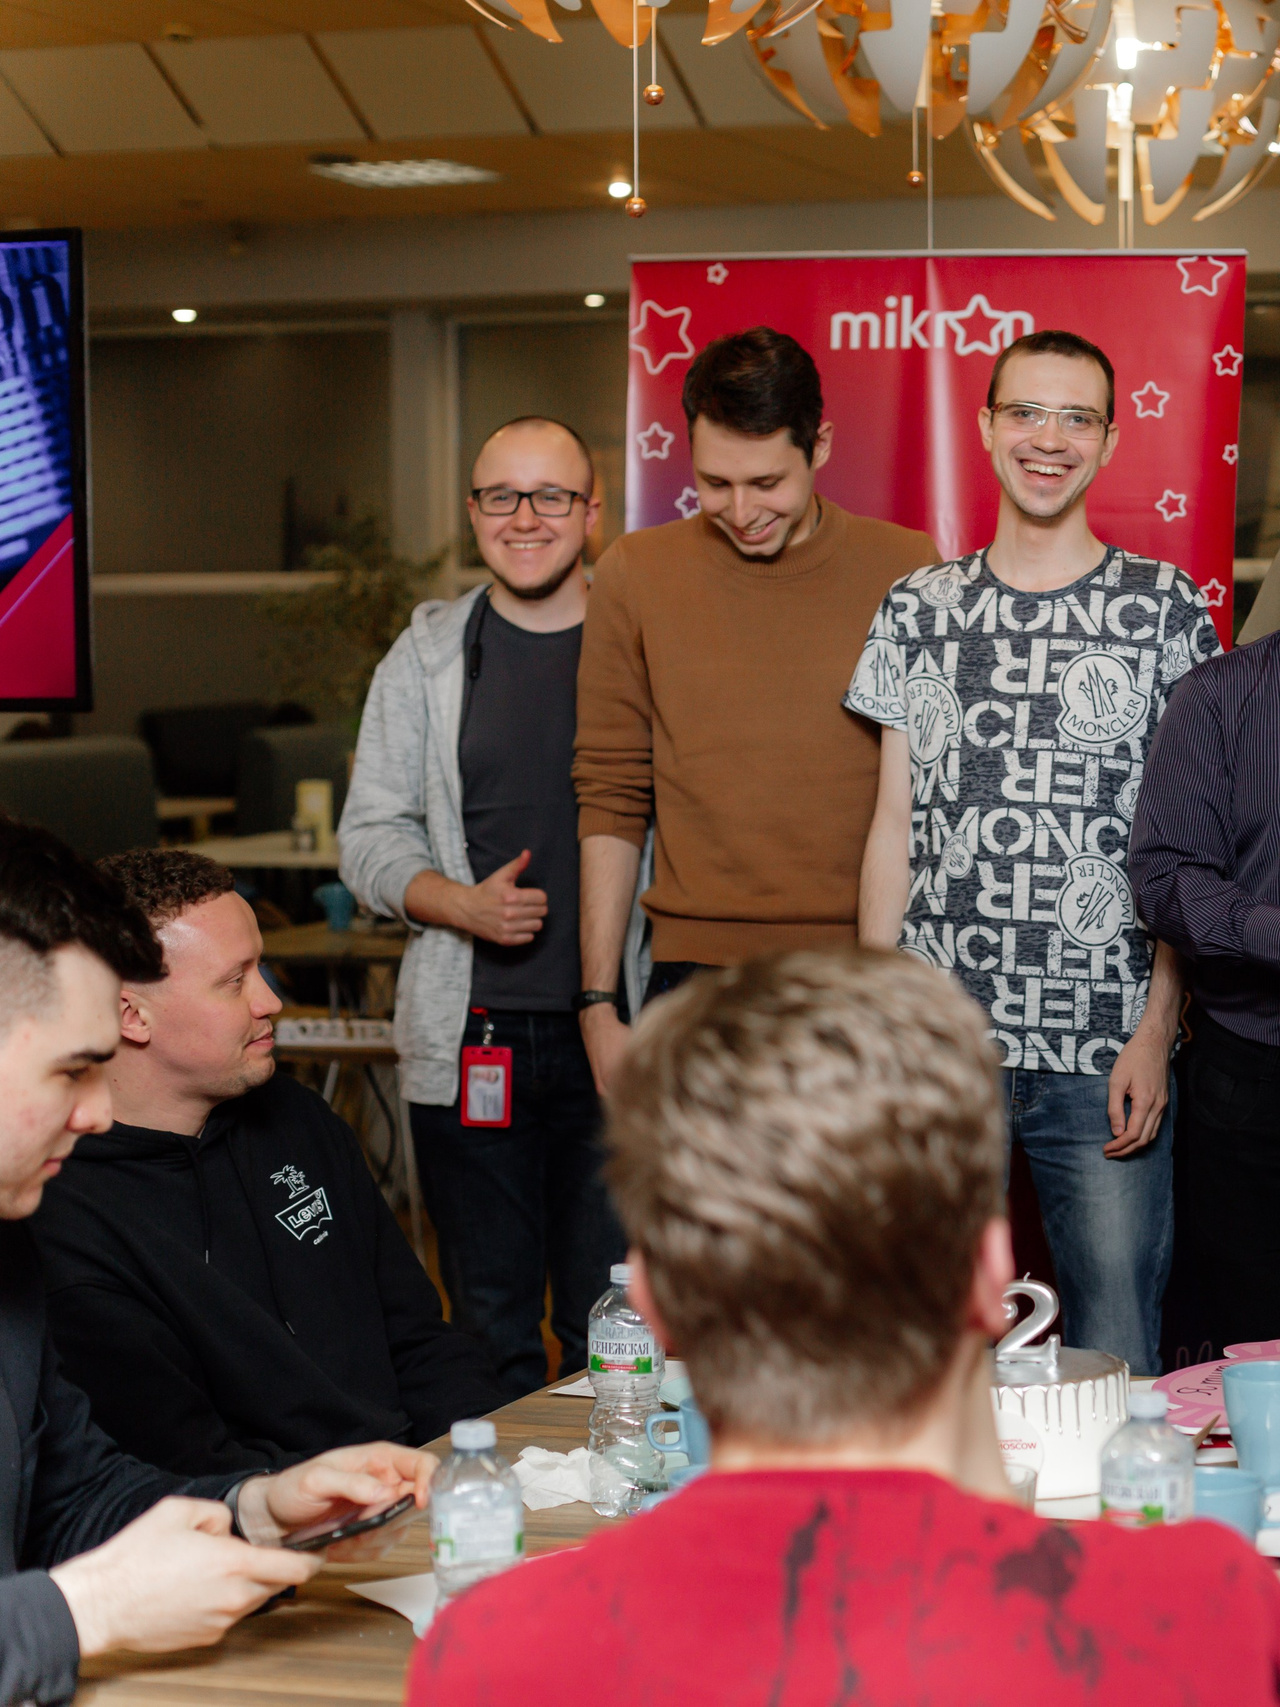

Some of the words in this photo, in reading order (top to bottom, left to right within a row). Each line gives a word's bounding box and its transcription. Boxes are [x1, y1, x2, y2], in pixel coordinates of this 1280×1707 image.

[1066, 699, 1142, 737] MONCLER
[1076, 863, 1132, 919] MONCLER
[996, 1278, 1061, 1363] 2
[591, 1339, 650, 1356] СЕНЕЖСКАЯ
